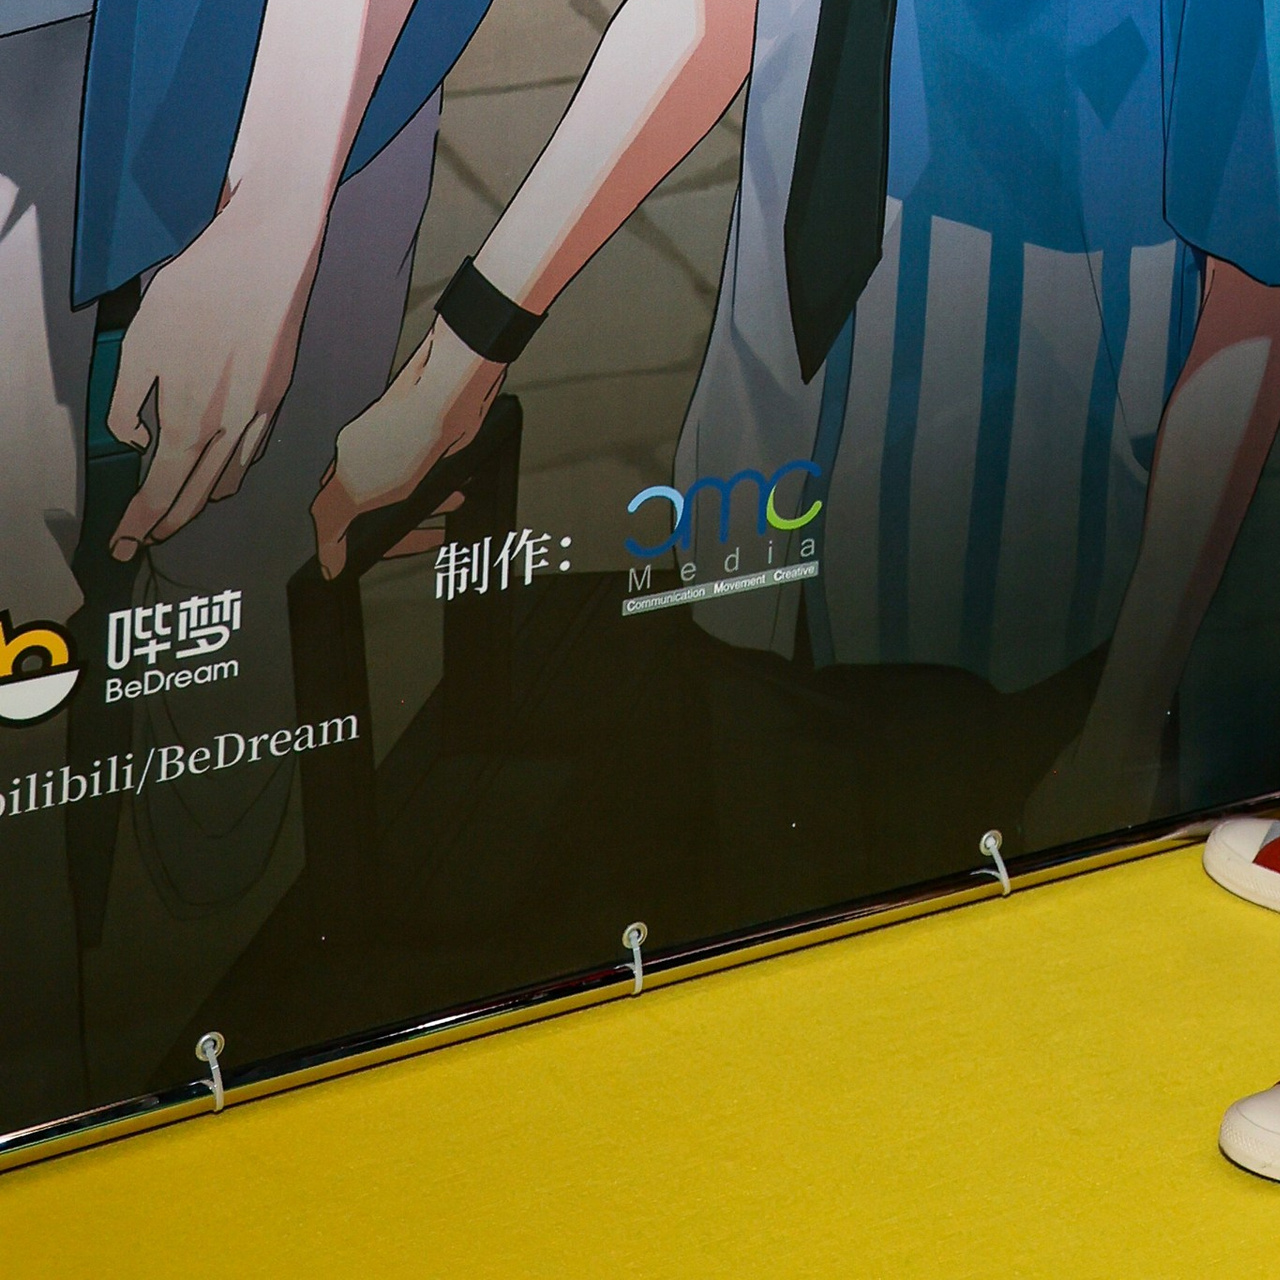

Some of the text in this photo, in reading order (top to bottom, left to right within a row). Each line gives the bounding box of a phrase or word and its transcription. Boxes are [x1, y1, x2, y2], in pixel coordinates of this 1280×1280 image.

[434, 528, 572, 601] 制作：
[626, 564, 815, 612] Communication Movement Creative
[628, 538, 815, 592] Media
[107, 589, 242, 670] 哔梦
[105, 659, 239, 703] BeDream
[0, 714, 360, 818] ilibili/BeDream
